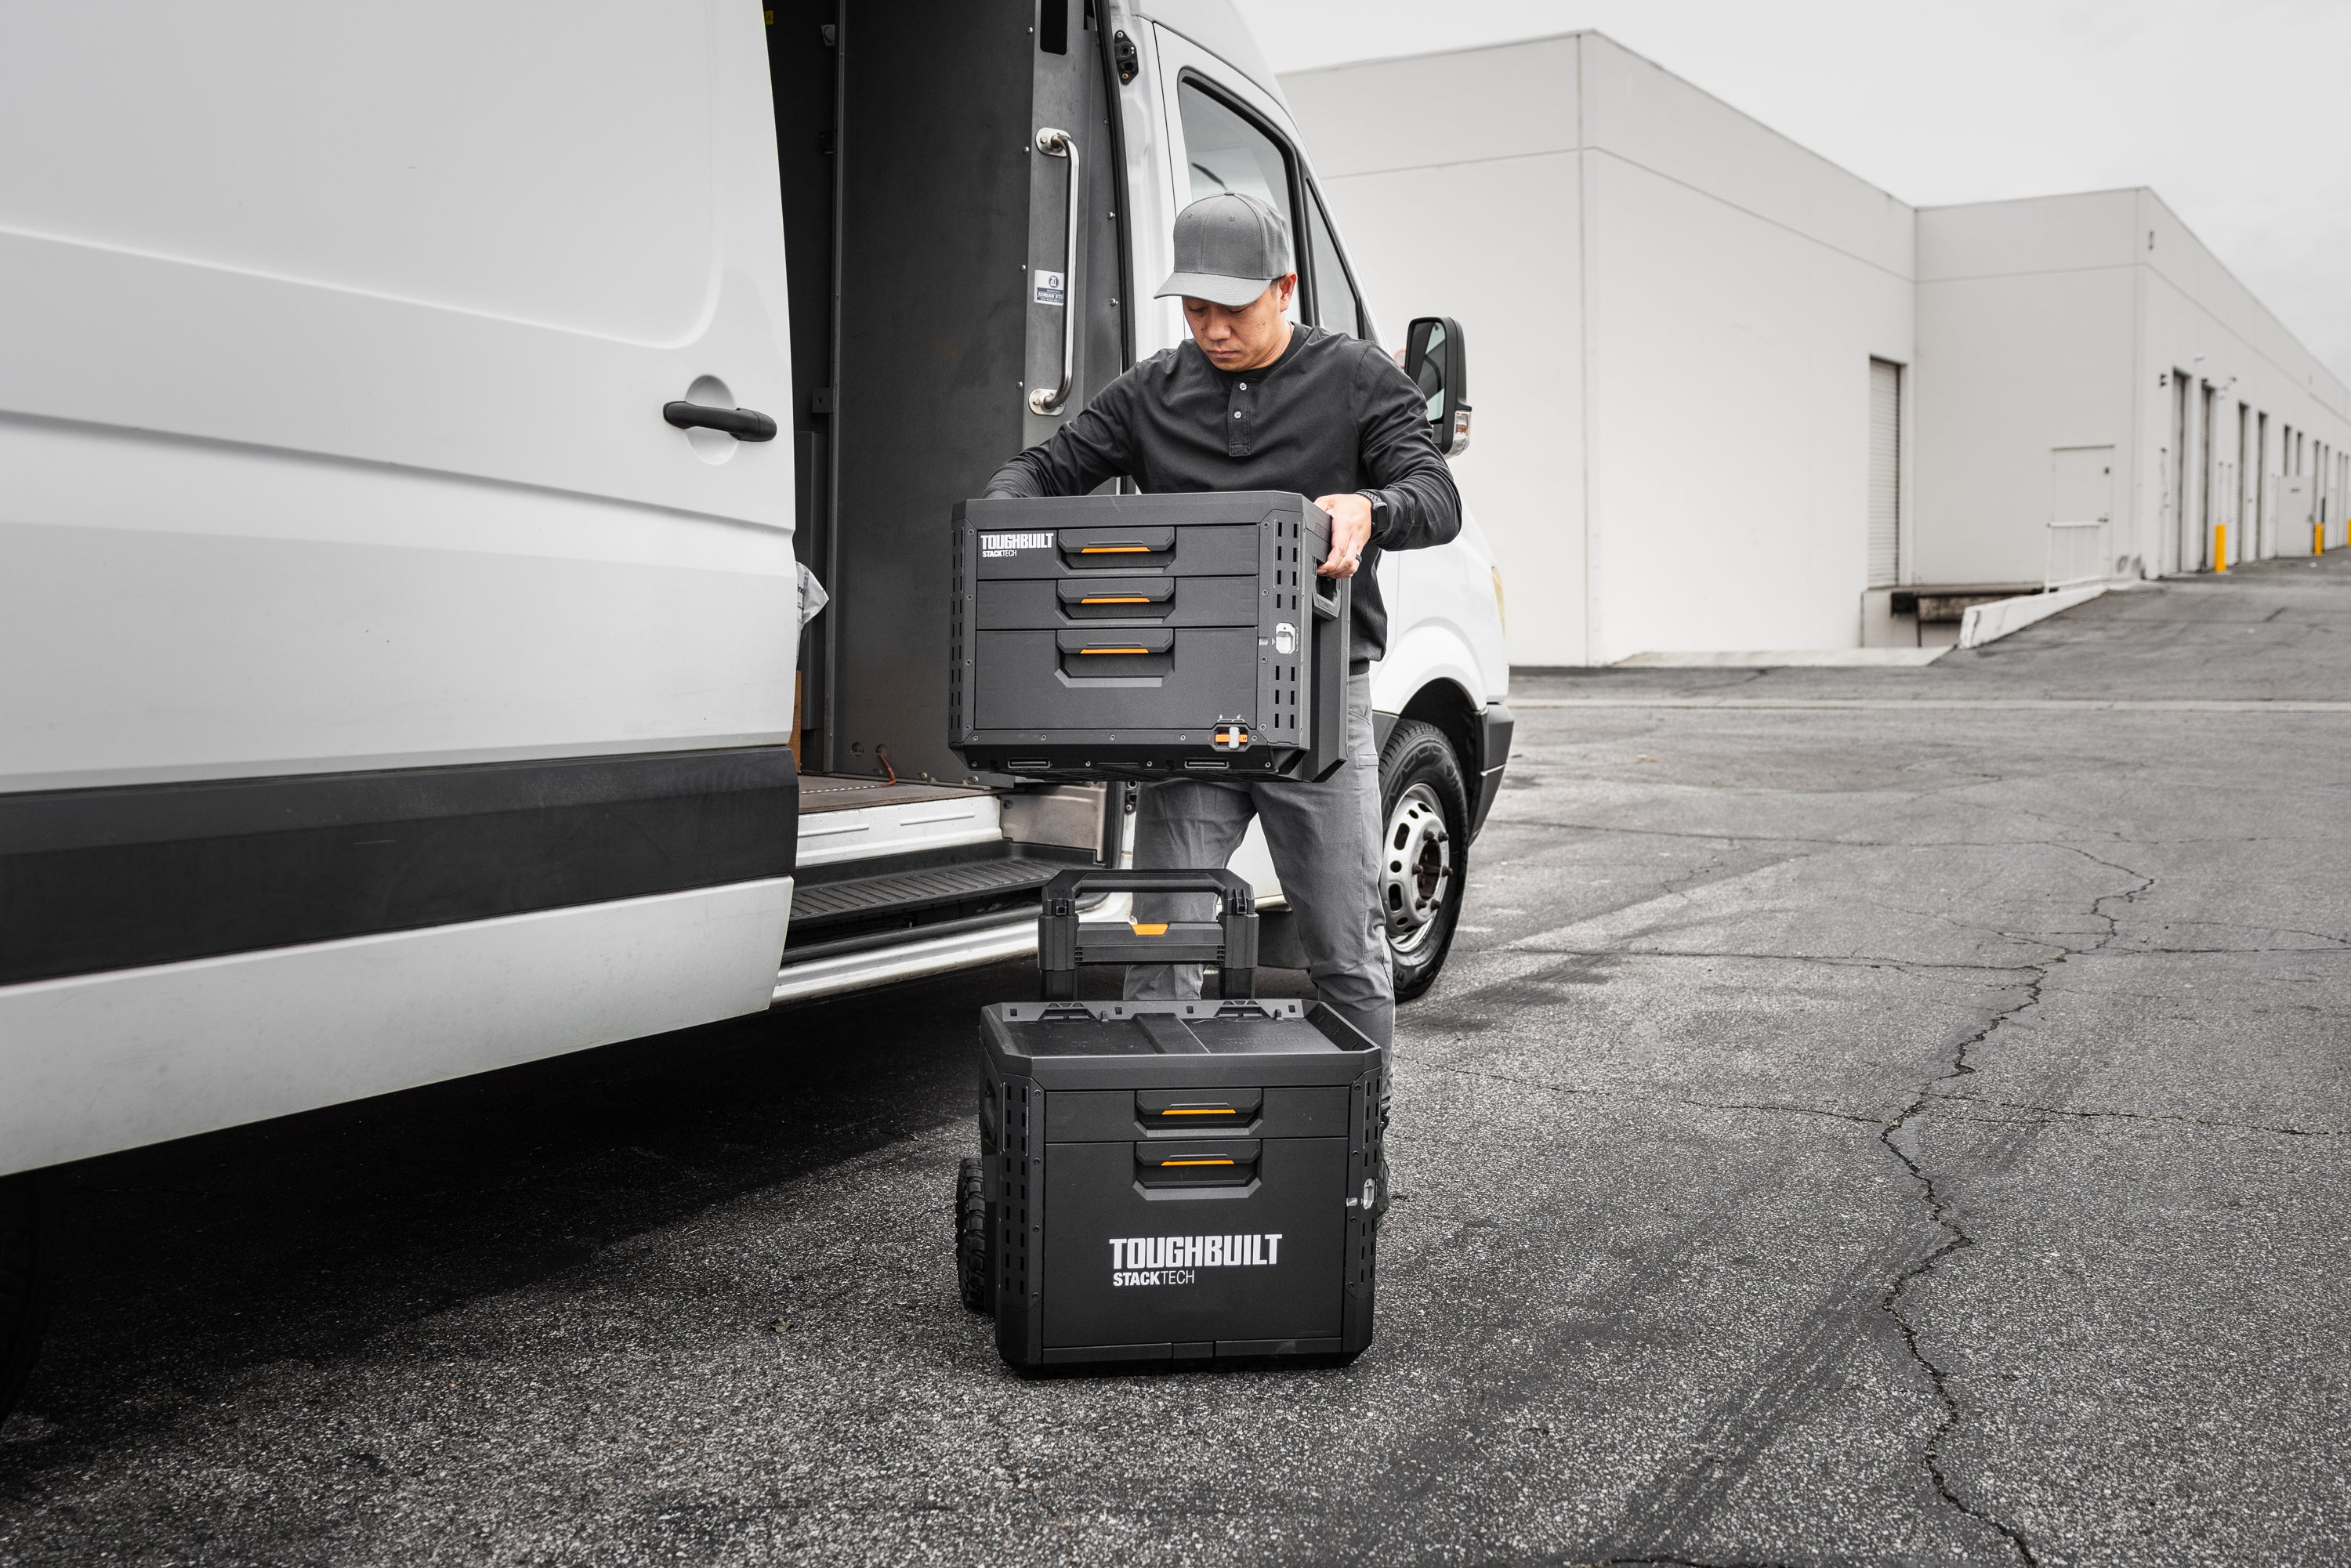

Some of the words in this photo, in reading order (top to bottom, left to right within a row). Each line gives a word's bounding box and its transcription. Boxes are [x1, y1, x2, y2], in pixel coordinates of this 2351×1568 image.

[980, 533, 1054, 549] TOUGHBUILT
[982, 549, 1017, 558] STACKTECH
[1109, 1233, 1283, 1269] TOUGHBUILT
[1113, 1269, 1195, 1287] STACKTECH
